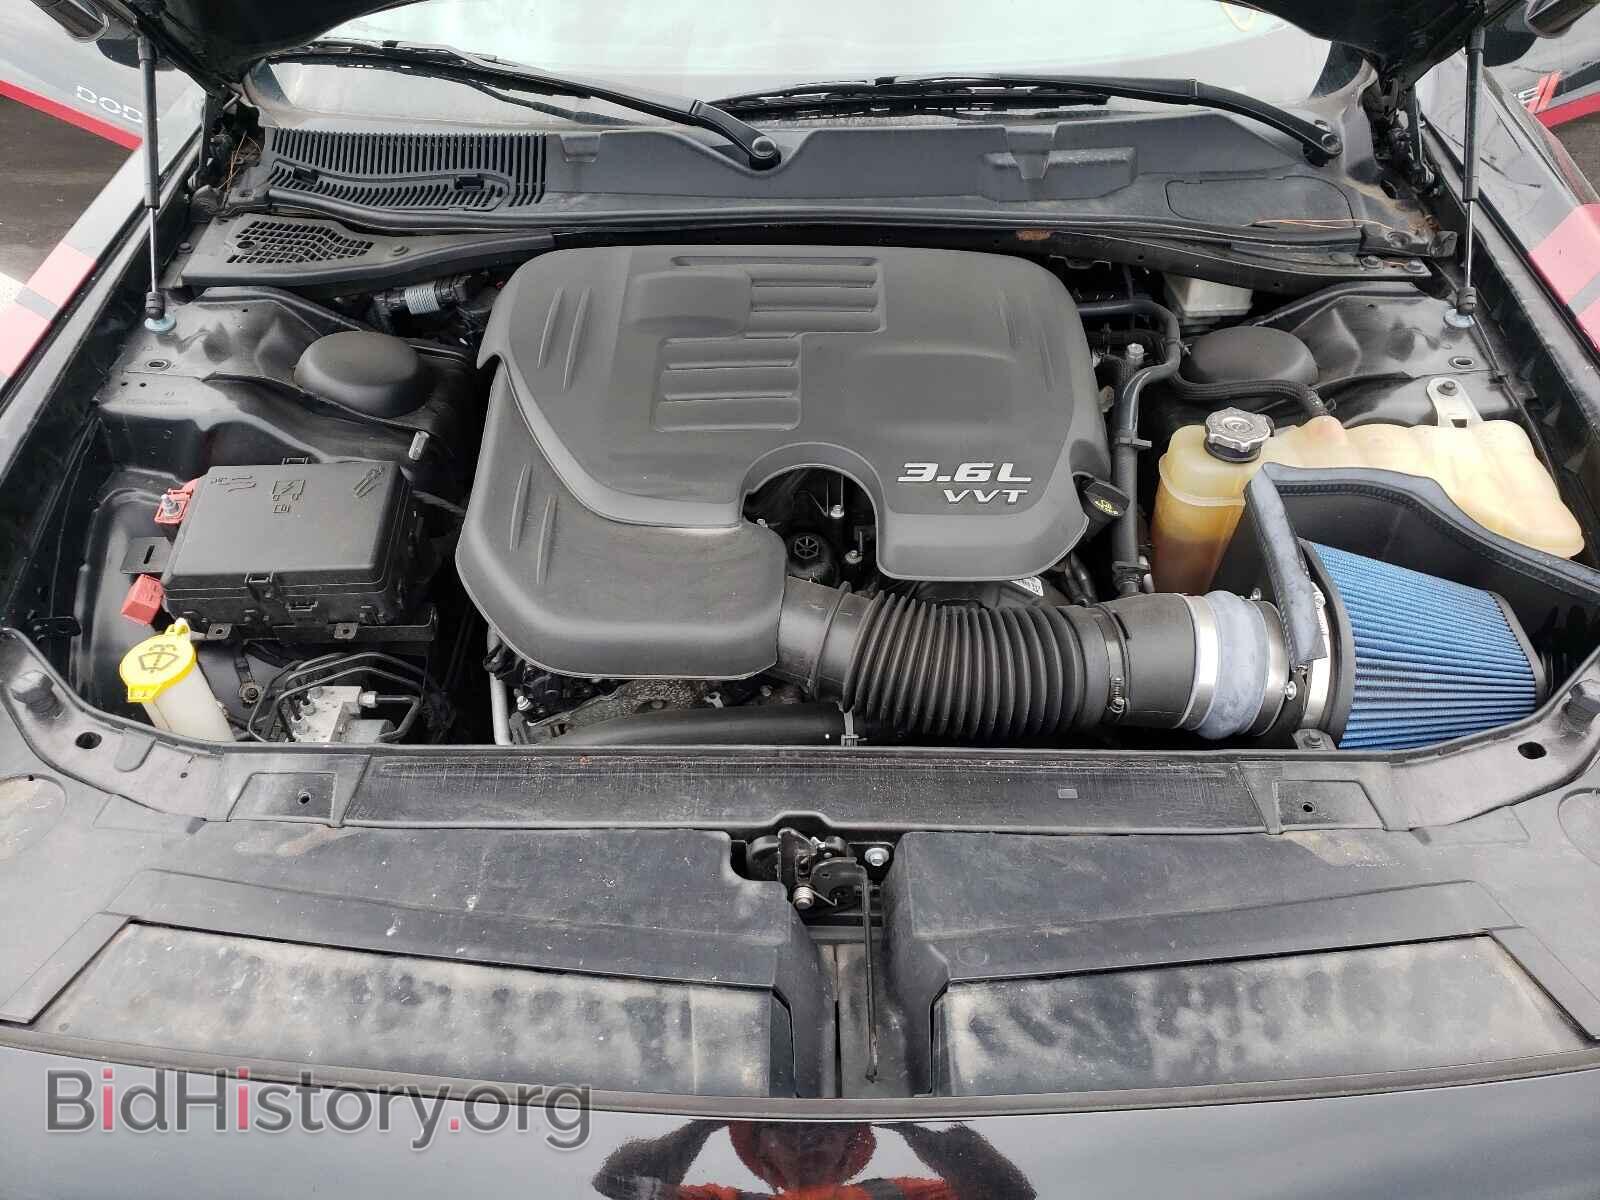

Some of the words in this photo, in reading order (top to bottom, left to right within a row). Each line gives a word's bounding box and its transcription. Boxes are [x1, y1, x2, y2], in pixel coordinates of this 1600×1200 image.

[76, 85, 159, 124] DOD
[896, 462, 1033, 483] 3.6L
[943, 489, 1028, 504] VVT
